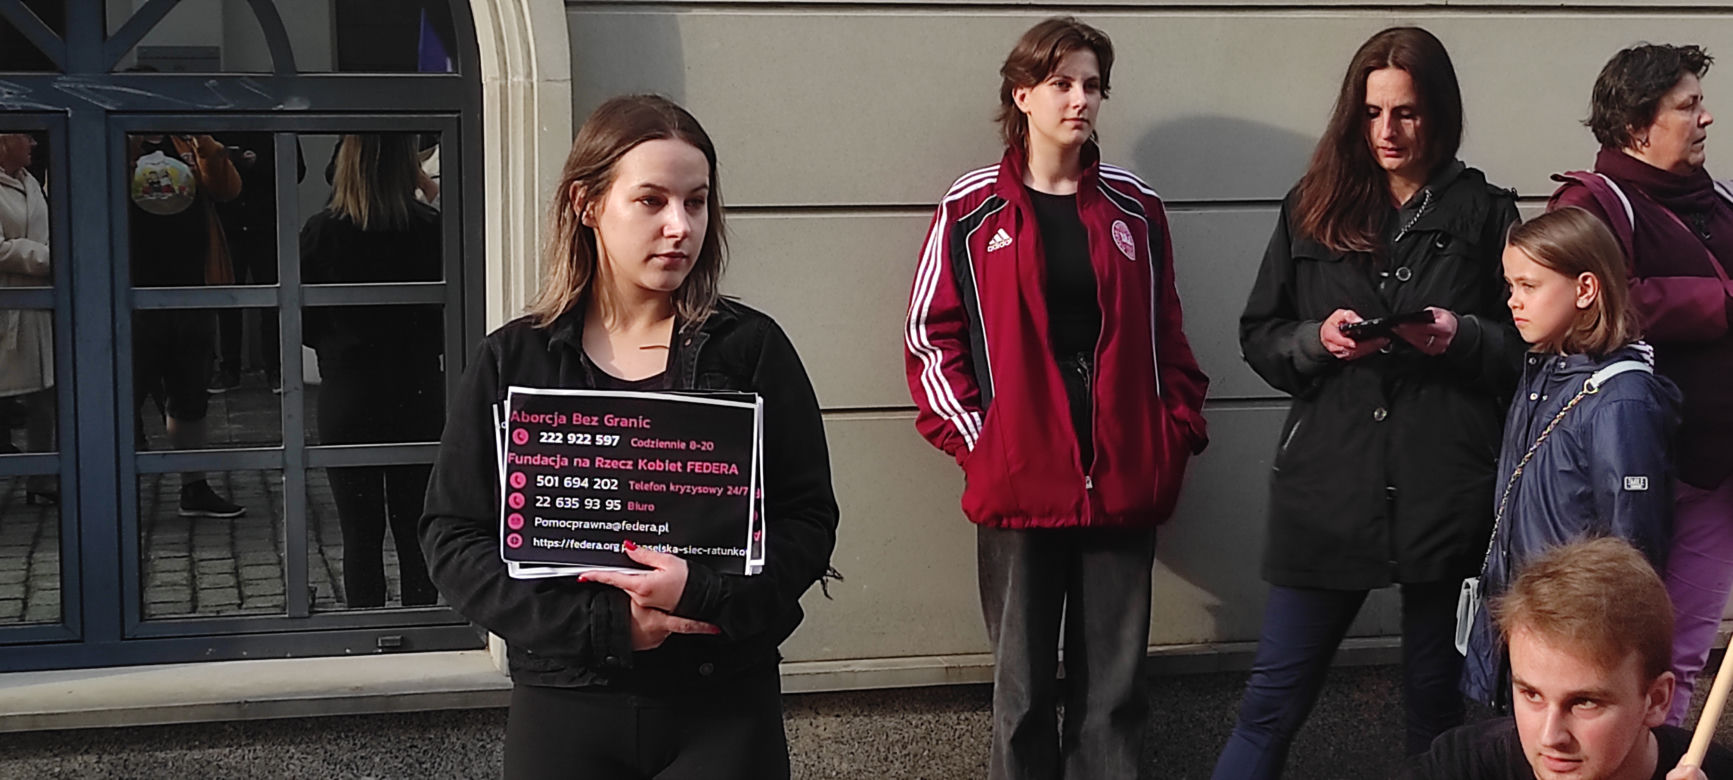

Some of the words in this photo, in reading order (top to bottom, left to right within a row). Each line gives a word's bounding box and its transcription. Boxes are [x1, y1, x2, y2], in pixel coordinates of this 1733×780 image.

[510, 410, 567, 427] Aborcja
[572, 413, 598, 427] Bez
[603, 414, 651, 429] Granic
[539, 432, 563, 444] 222
[567, 433, 592, 445] 922
[595, 434, 620, 446] 597
[631, 438, 686, 450] Codziennie
[689, 440, 714, 451] 8-20
[508, 453, 568, 467] Fundacja
[573, 456, 590, 467] na
[595, 457, 633, 470] Rzecz
[638, 459, 682, 472] Kobiet
[687, 462, 739, 475] FEDERA
[536, 474, 559, 487] 501
[563, 475, 589, 488] 694
[593, 477, 619, 490] 202
[628, 480, 666, 492] Telefon
[669, 482, 723, 496] kryzysowy
[727, 486, 748, 496] 24/7
[535, 495, 551, 508] 22
[555, 496, 579, 509] 635
[584, 498, 600, 510] 93
[605, 499, 621, 510] 95
[628, 502, 655, 511] Biuro
[534, 517, 670, 534] Pomocprawna@federa.pl
